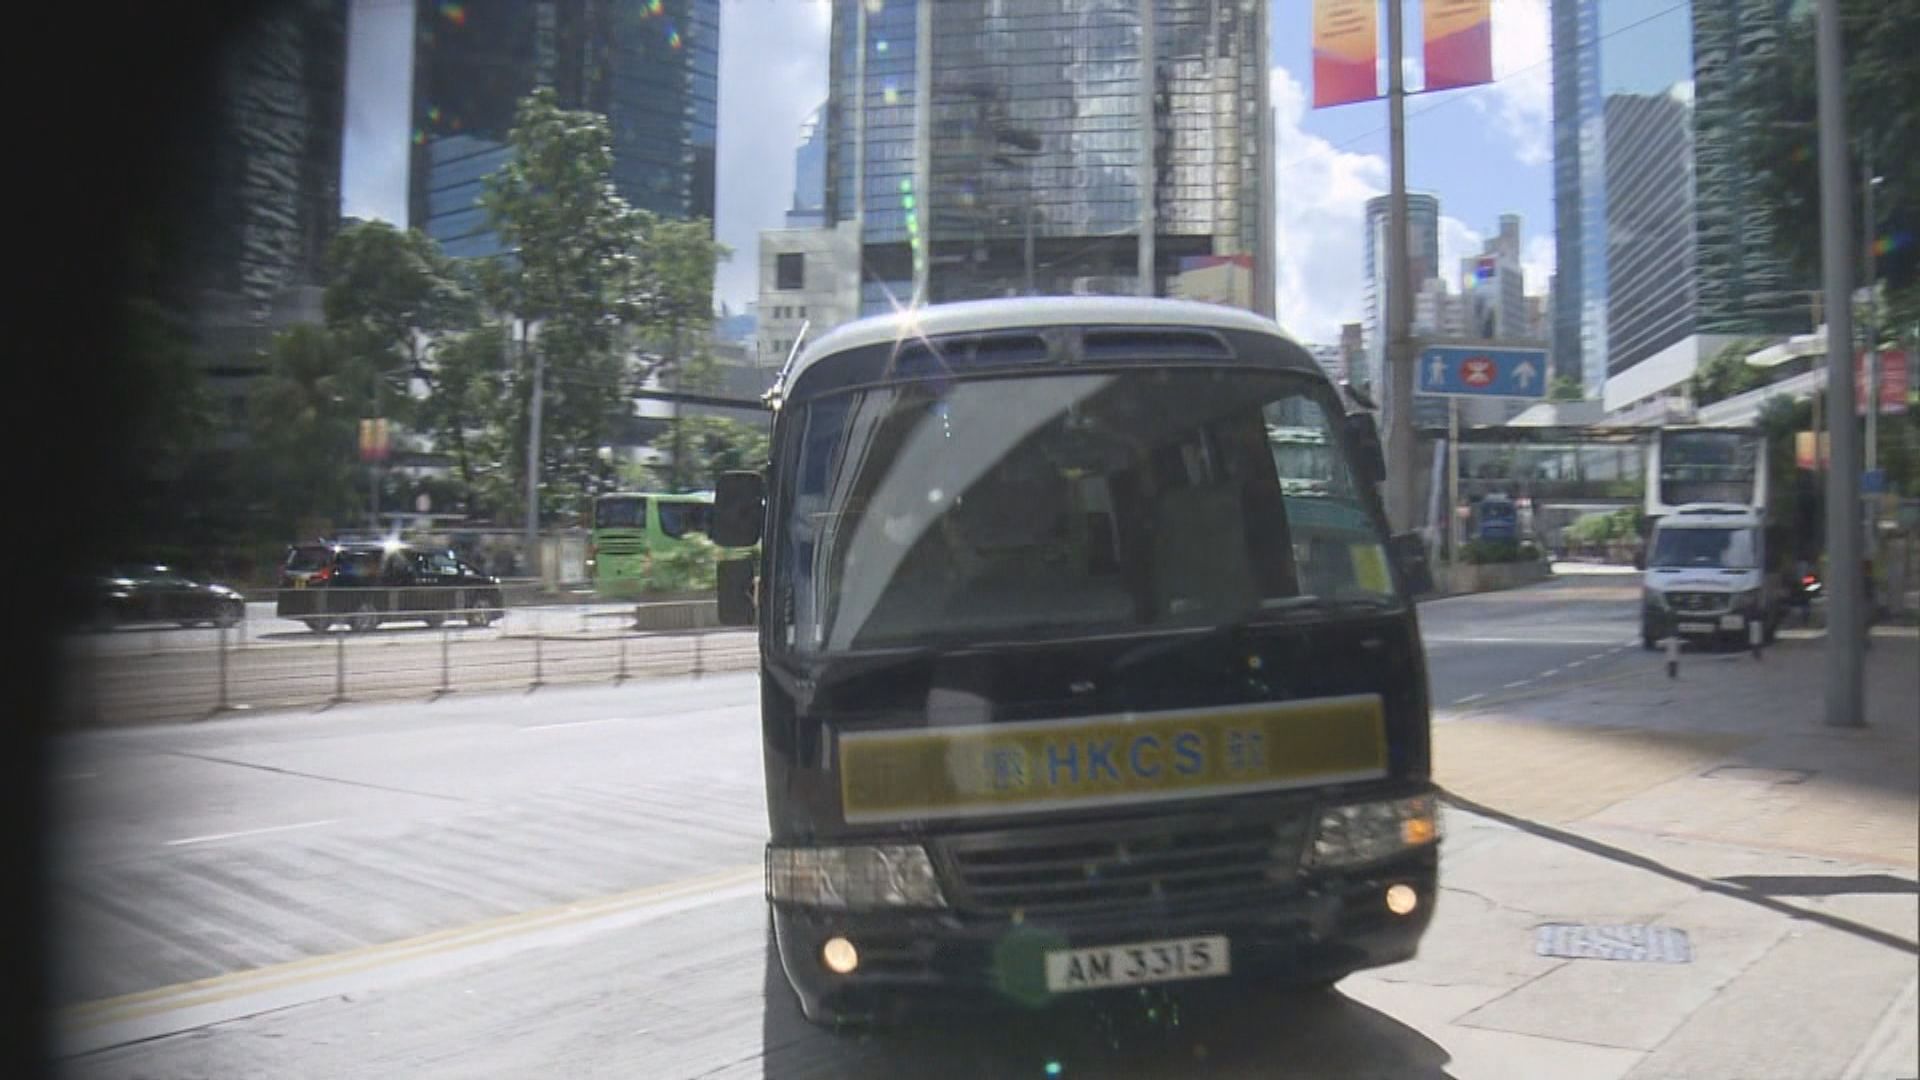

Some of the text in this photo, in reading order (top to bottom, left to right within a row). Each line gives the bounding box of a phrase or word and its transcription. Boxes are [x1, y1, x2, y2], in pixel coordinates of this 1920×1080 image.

[1047, 731, 1205, 785] HKCS
[1068, 941, 1211, 983] AM 3315
